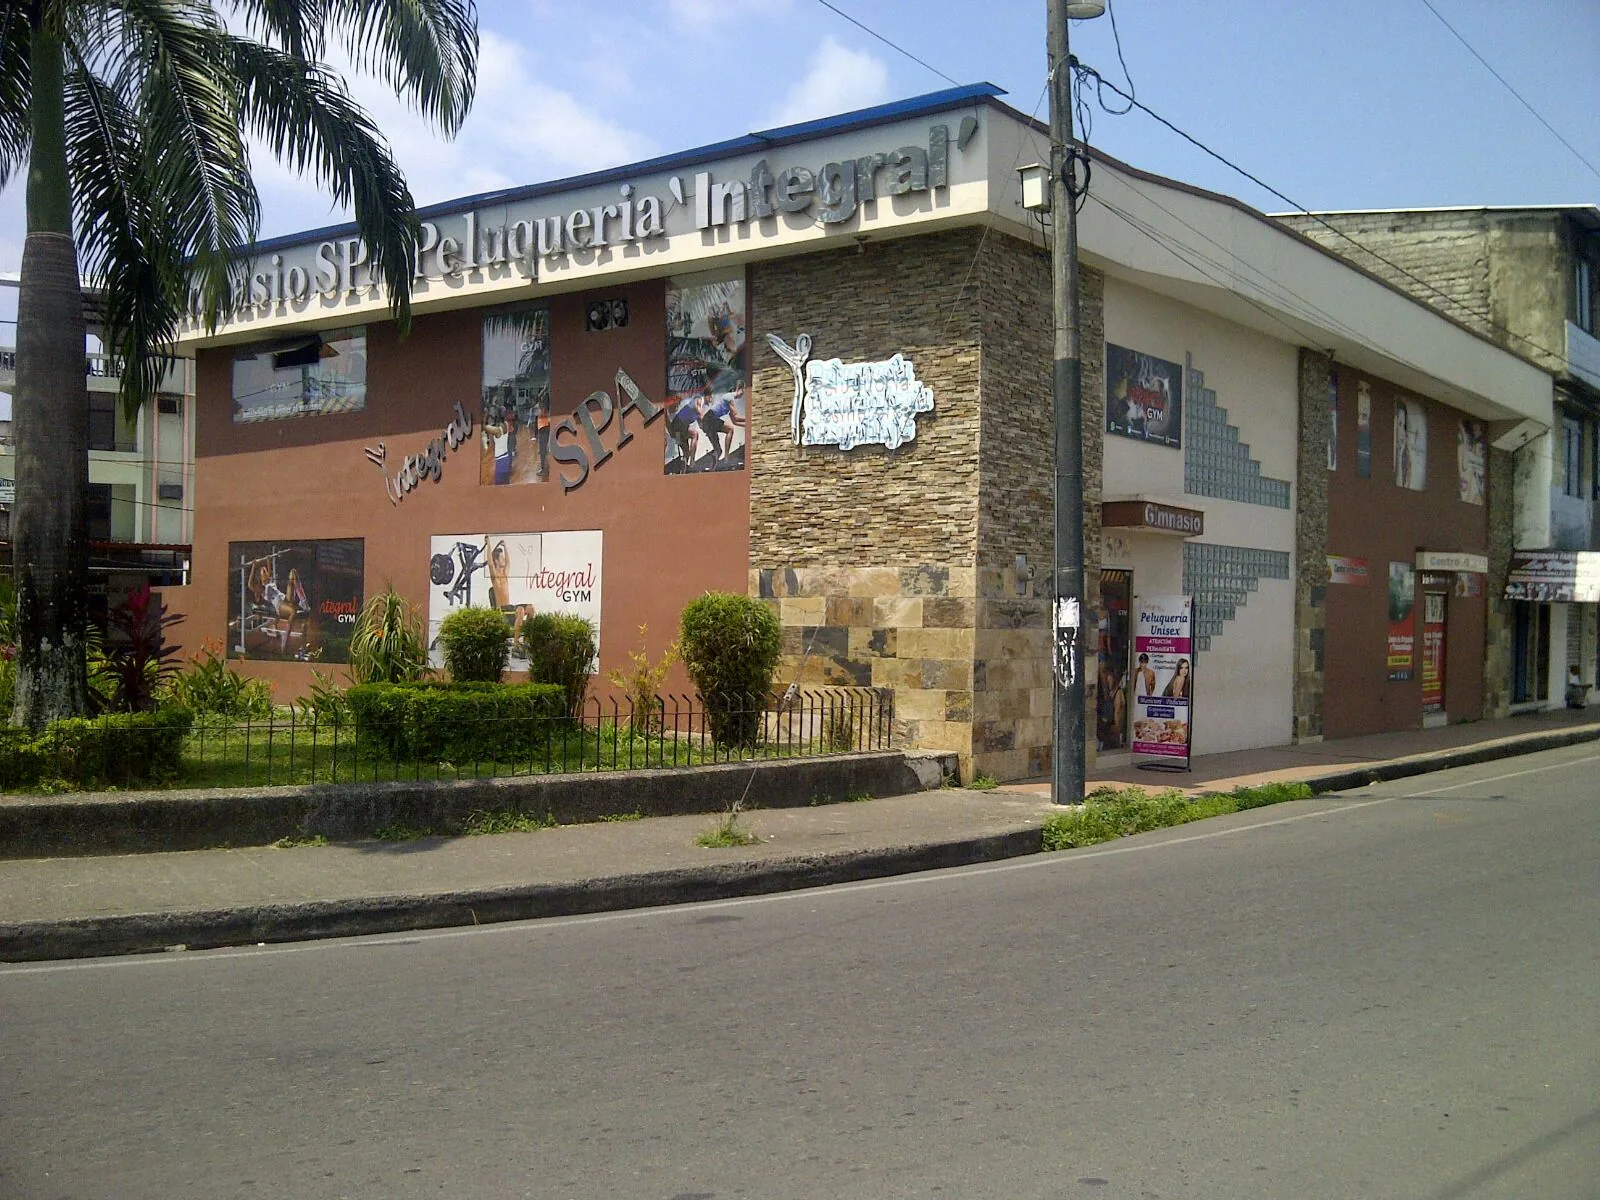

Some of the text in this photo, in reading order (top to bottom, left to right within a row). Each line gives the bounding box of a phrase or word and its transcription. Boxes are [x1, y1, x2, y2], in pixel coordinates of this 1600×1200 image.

[1147, 407, 1163, 421] GYM
[549, 366, 665, 496] SPA
[384, 400, 472, 507] Integral
[1144, 503, 1201, 533] Gimnasio
[562, 590, 591, 602] GYM
[337, 614, 356, 623] GYM
[1150, 625, 1180, 636] Unisex
